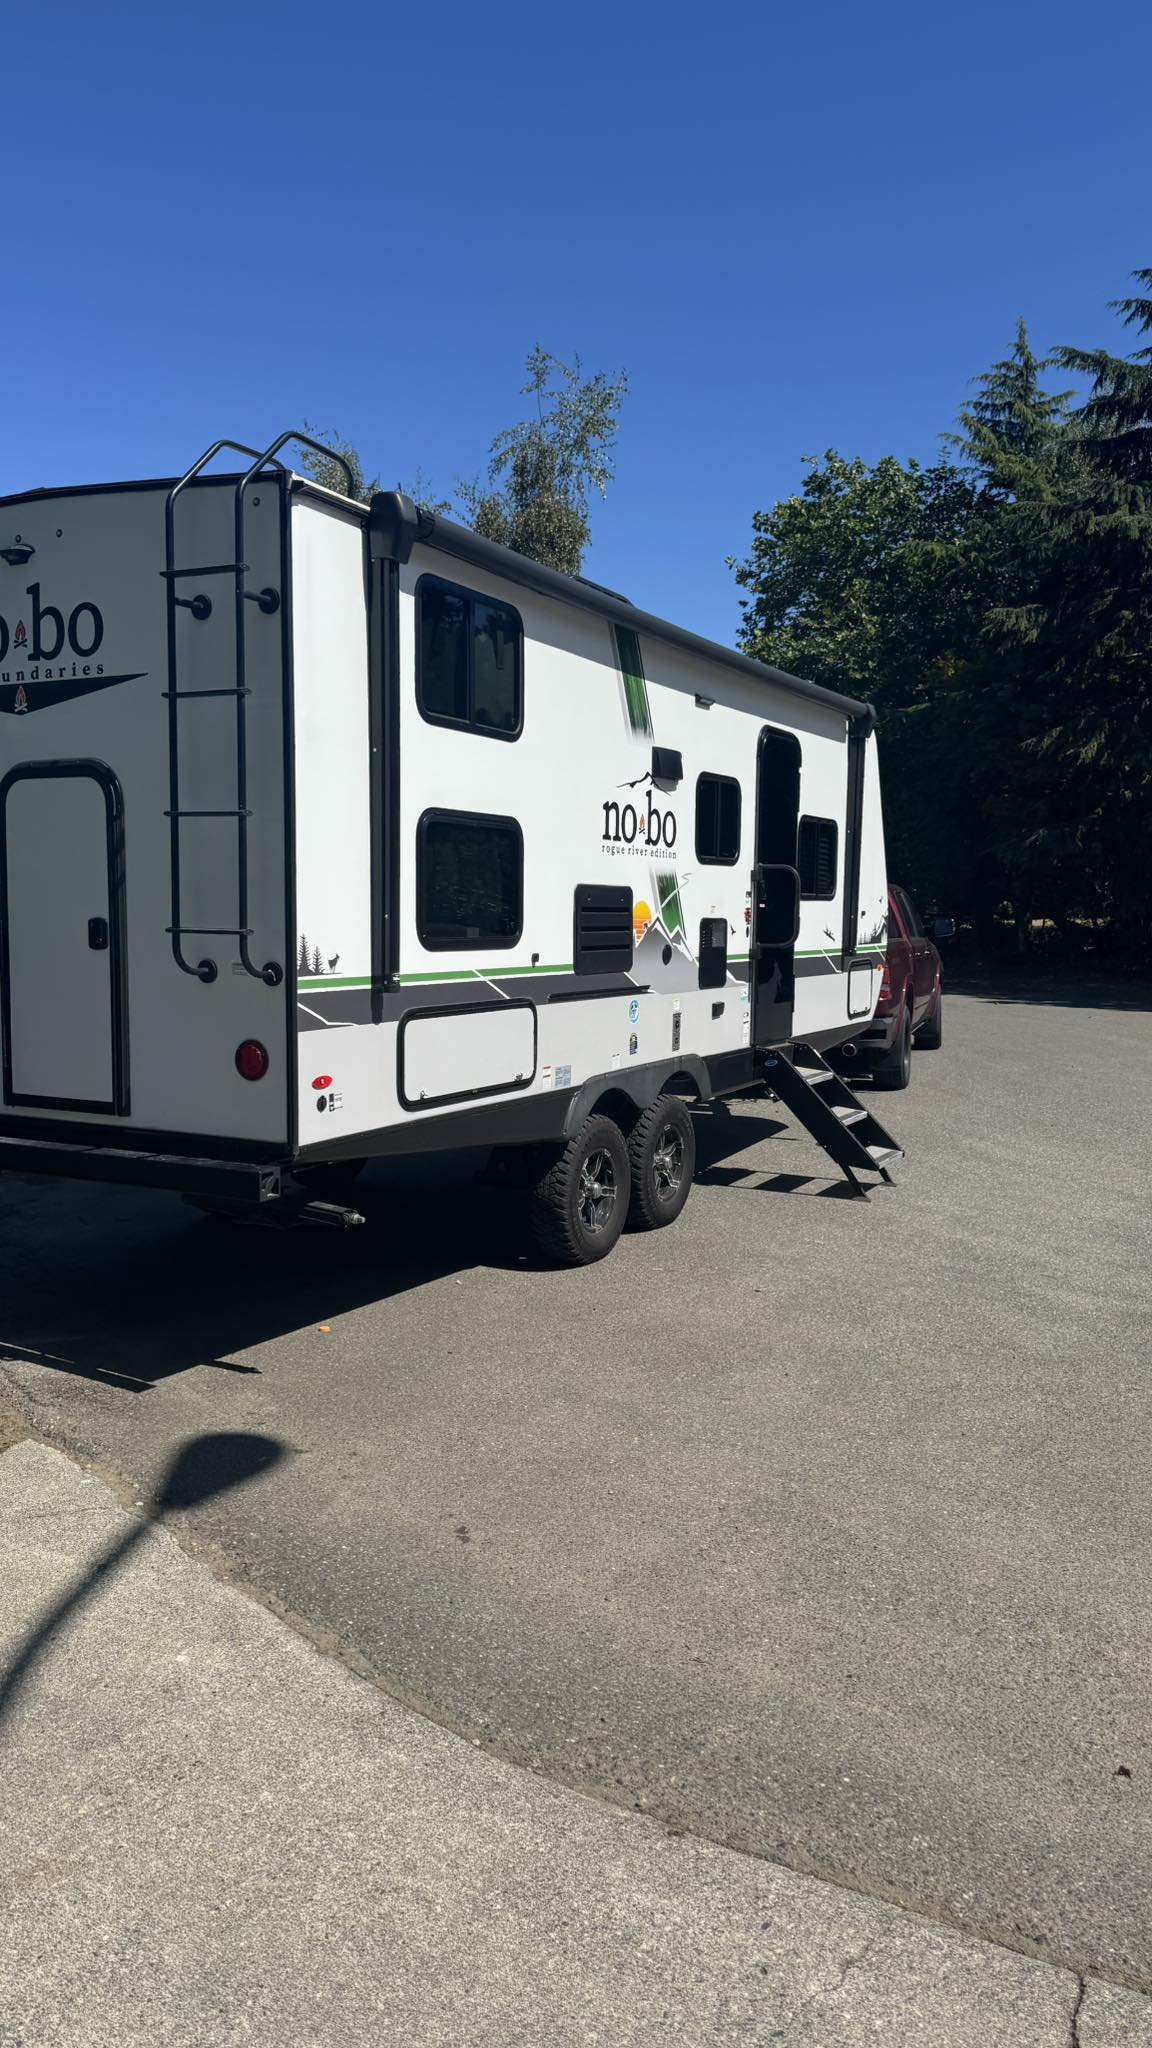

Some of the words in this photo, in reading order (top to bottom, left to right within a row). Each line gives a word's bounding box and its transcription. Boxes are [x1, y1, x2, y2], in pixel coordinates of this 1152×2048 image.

[0, 582, 104, 663] bo
[601, 845, 625, 856] rogue
[628, 845, 648, 857] river
[650, 848, 677, 860] edition
